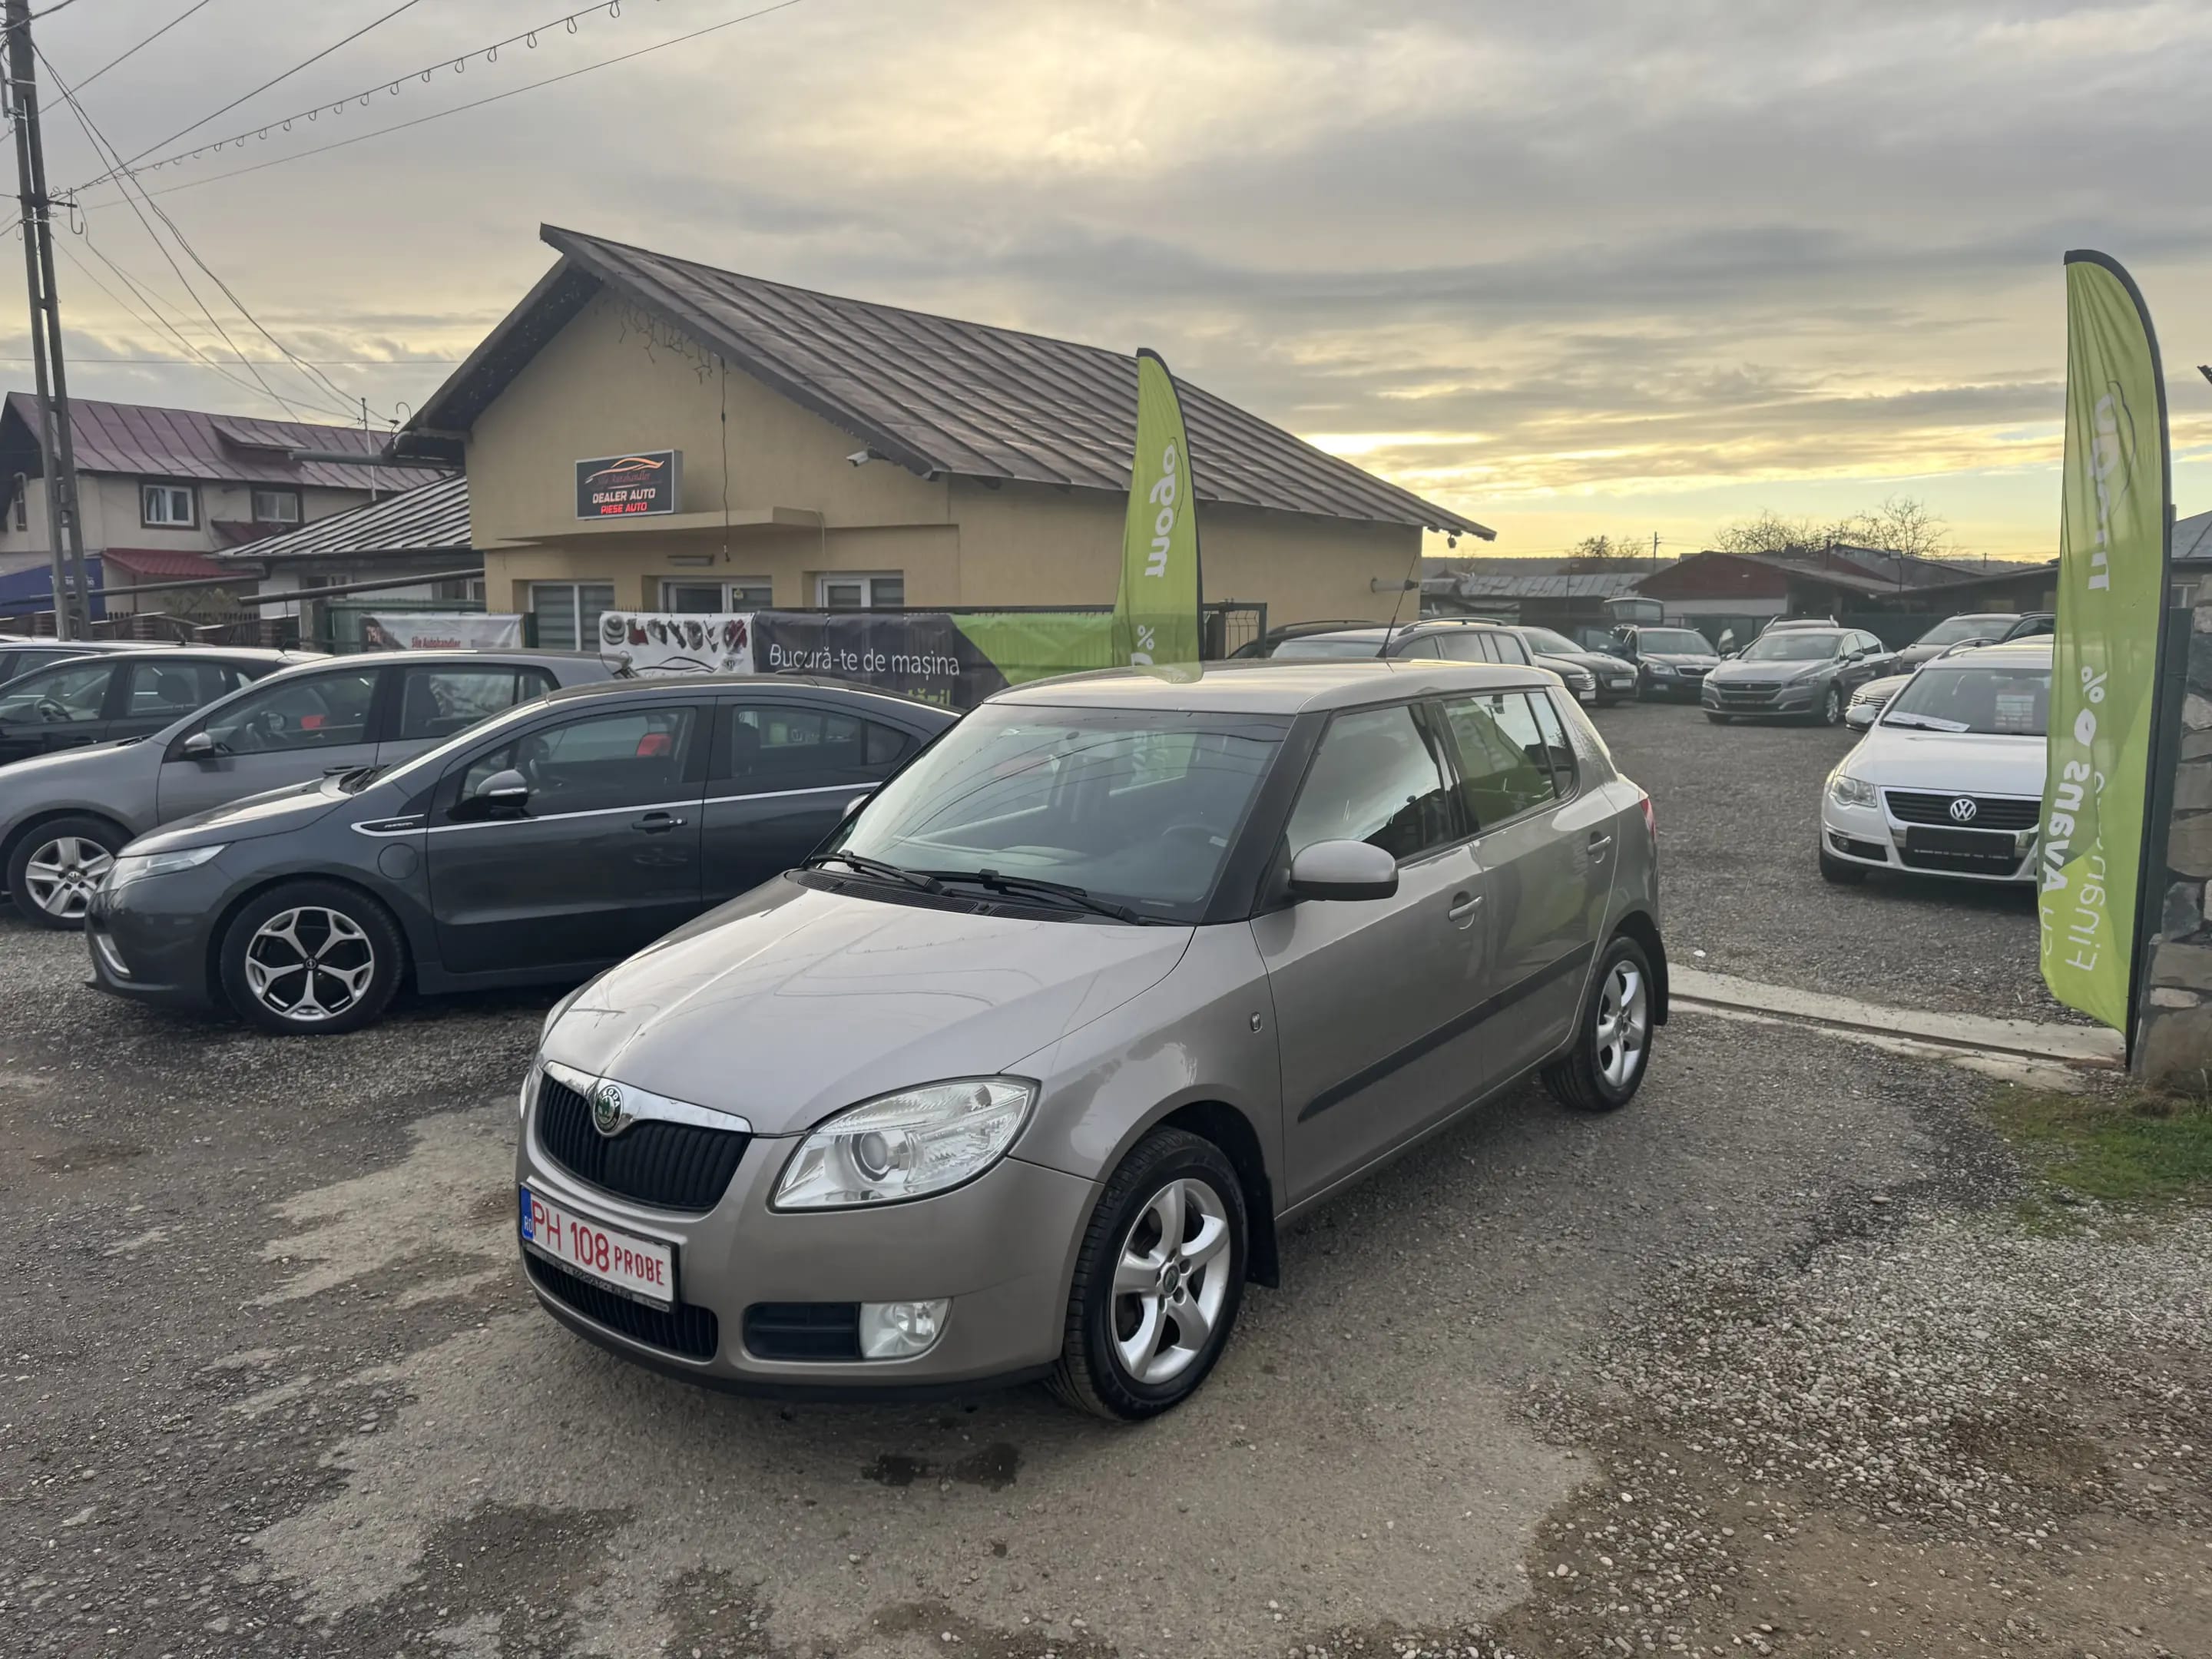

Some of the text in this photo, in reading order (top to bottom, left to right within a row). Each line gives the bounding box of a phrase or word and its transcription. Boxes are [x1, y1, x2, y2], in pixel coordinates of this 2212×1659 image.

[592, 488, 656, 504] DEALER AUTO
[601, 502, 647, 515] PIESE AUTO
[770, 644, 960, 681] Bucură-te de mașina
[525, 1216, 533, 1233] RO
[531, 1200, 561, 1251] PH
[571, 1221, 610, 1273] 108
[614, 1245, 665, 1286] PROBE
